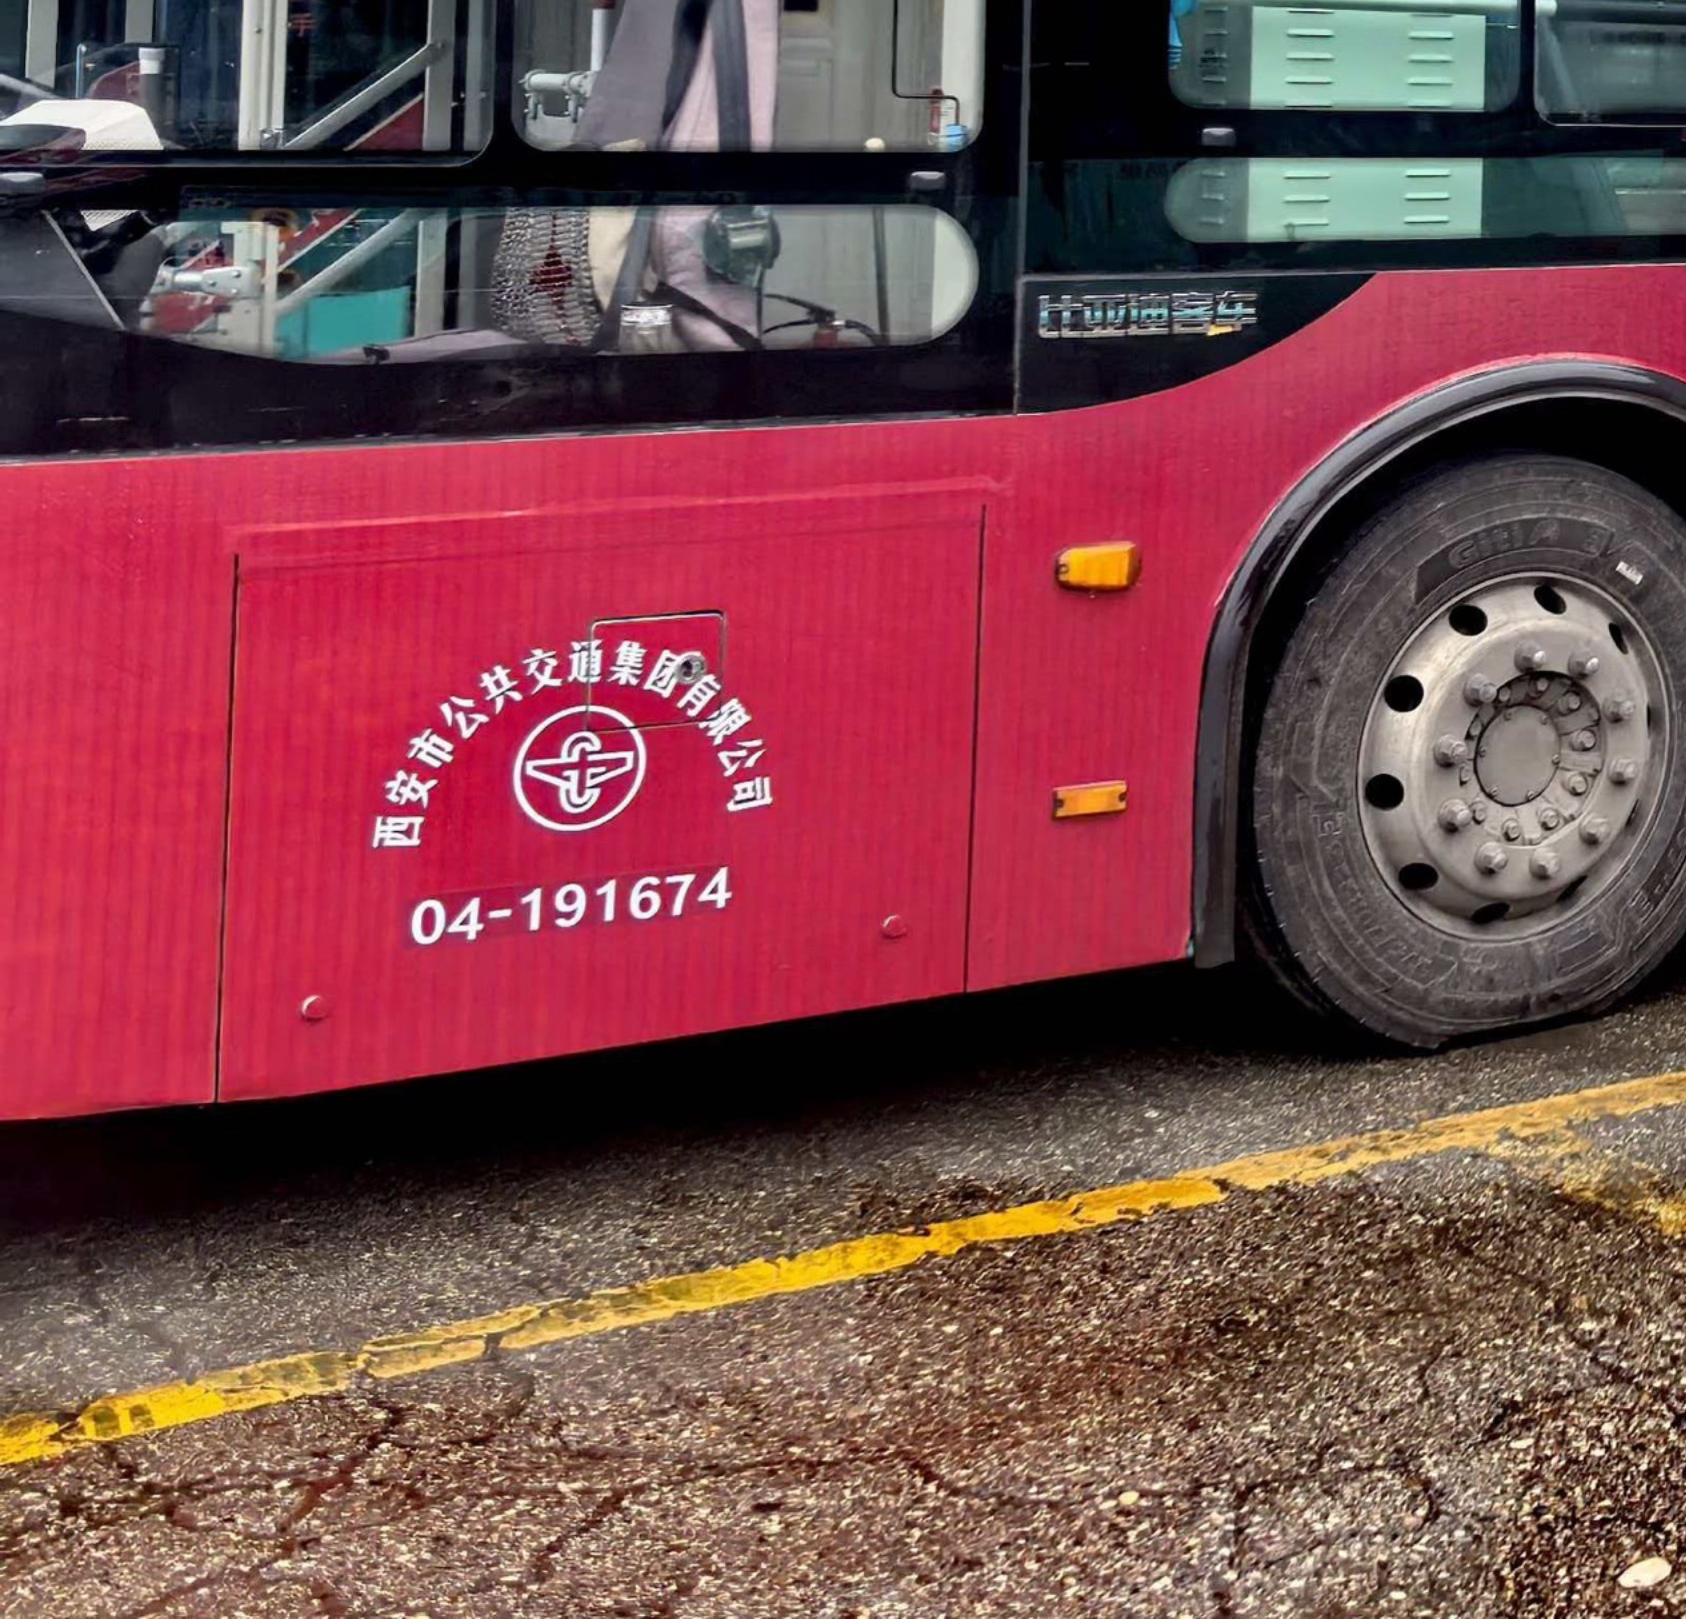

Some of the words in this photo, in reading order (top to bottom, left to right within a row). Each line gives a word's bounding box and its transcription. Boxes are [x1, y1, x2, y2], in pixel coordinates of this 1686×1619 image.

[1037, 290, 1259, 339] 比亚迪客车
[371, 639, 774, 851] 西安市公共交通集团有限公司
[410, 866, 733, 946] 04-191674
